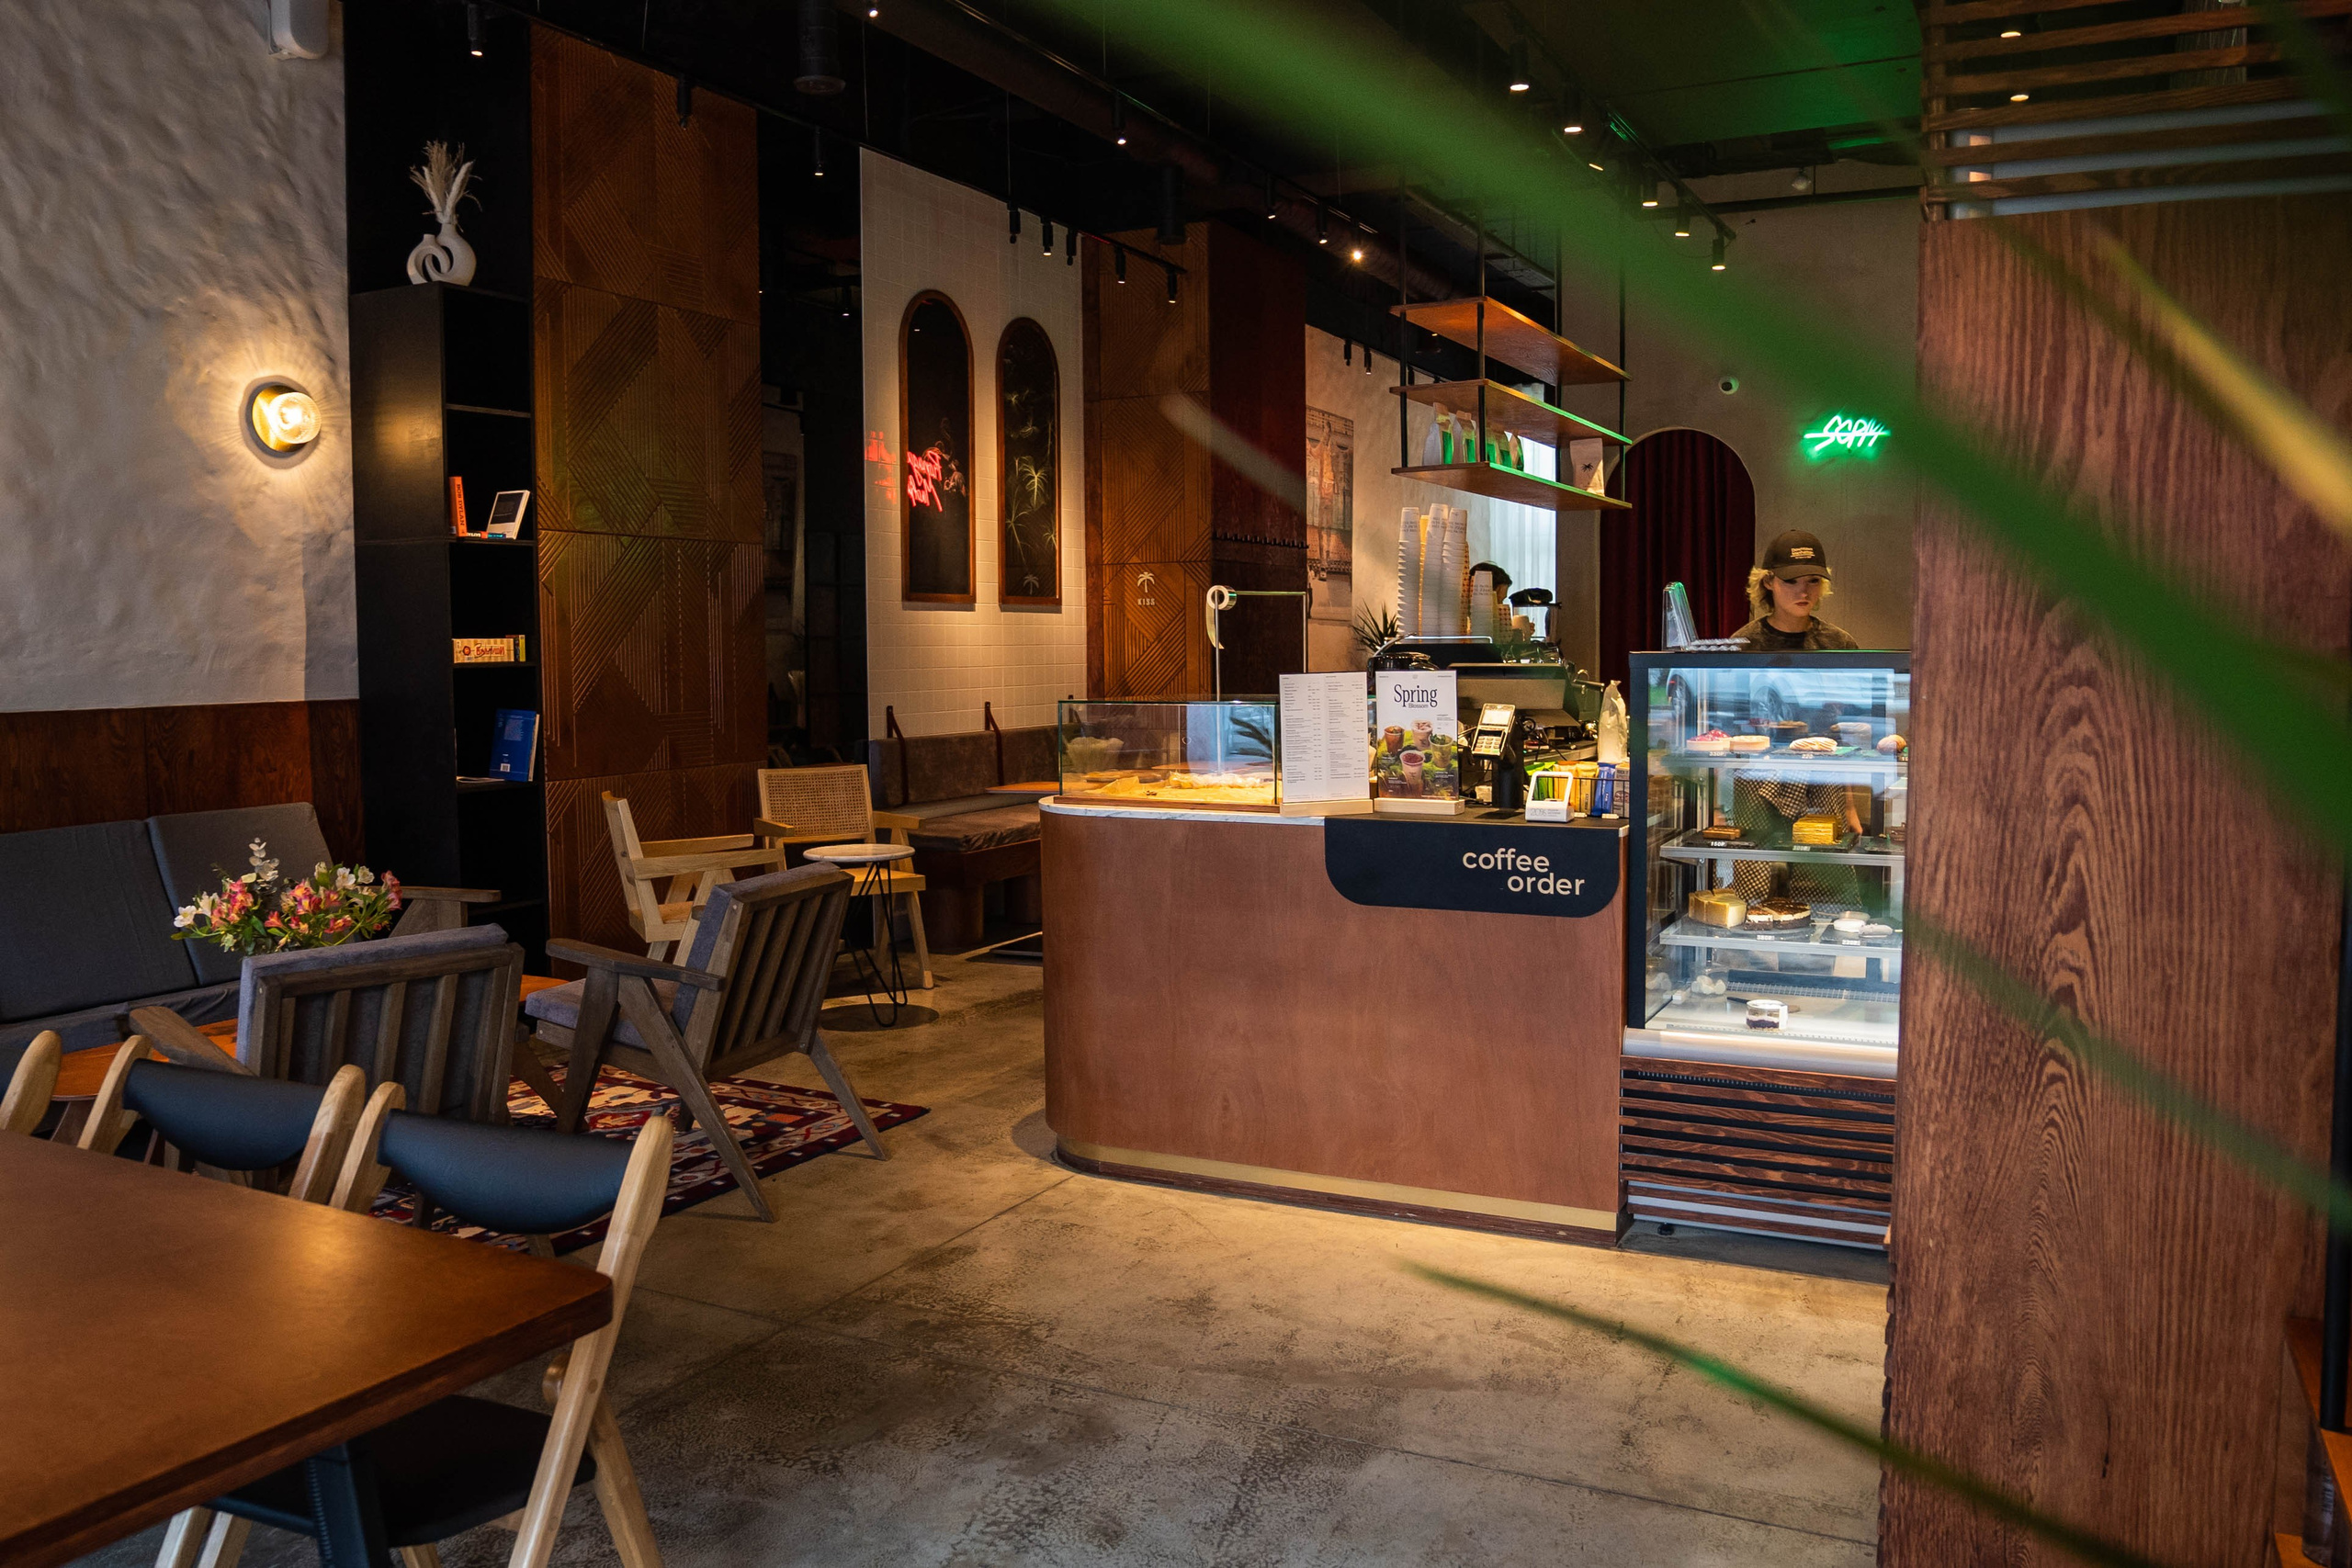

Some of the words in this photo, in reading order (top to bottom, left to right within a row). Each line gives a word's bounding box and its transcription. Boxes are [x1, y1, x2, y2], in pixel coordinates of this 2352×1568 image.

[1137, 598, 1156, 606] KISS
[1394, 683, 1438, 707] Spring
[1463, 848, 1550, 873] coffee
[1508, 873, 1585, 895] order
